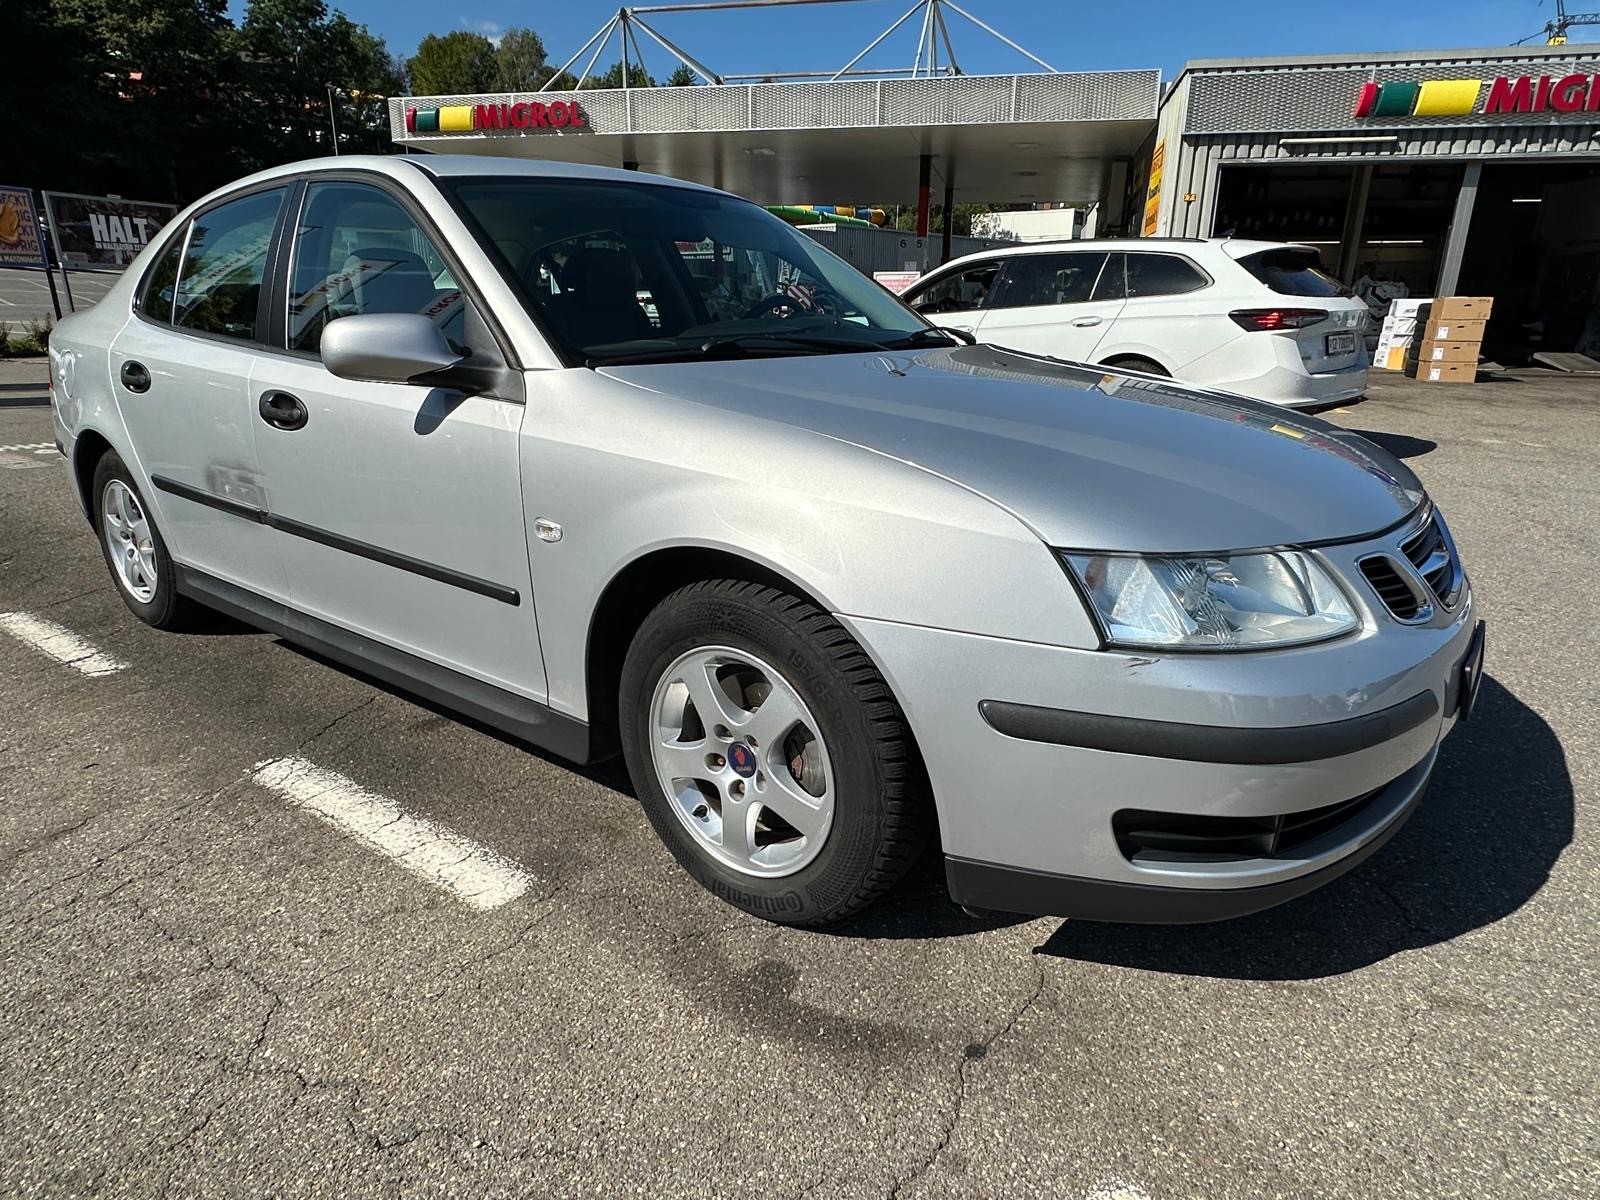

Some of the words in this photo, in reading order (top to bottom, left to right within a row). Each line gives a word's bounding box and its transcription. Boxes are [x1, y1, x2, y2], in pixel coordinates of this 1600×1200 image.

[475, 100, 585, 129] MIGROL
[0, 192, 27, 207] ECKT
[89, 214, 148, 245] HALT
[900, 239, 907, 248] 6
[916, 239, 923, 248] 5
[711, 878, 804, 914] Continental
